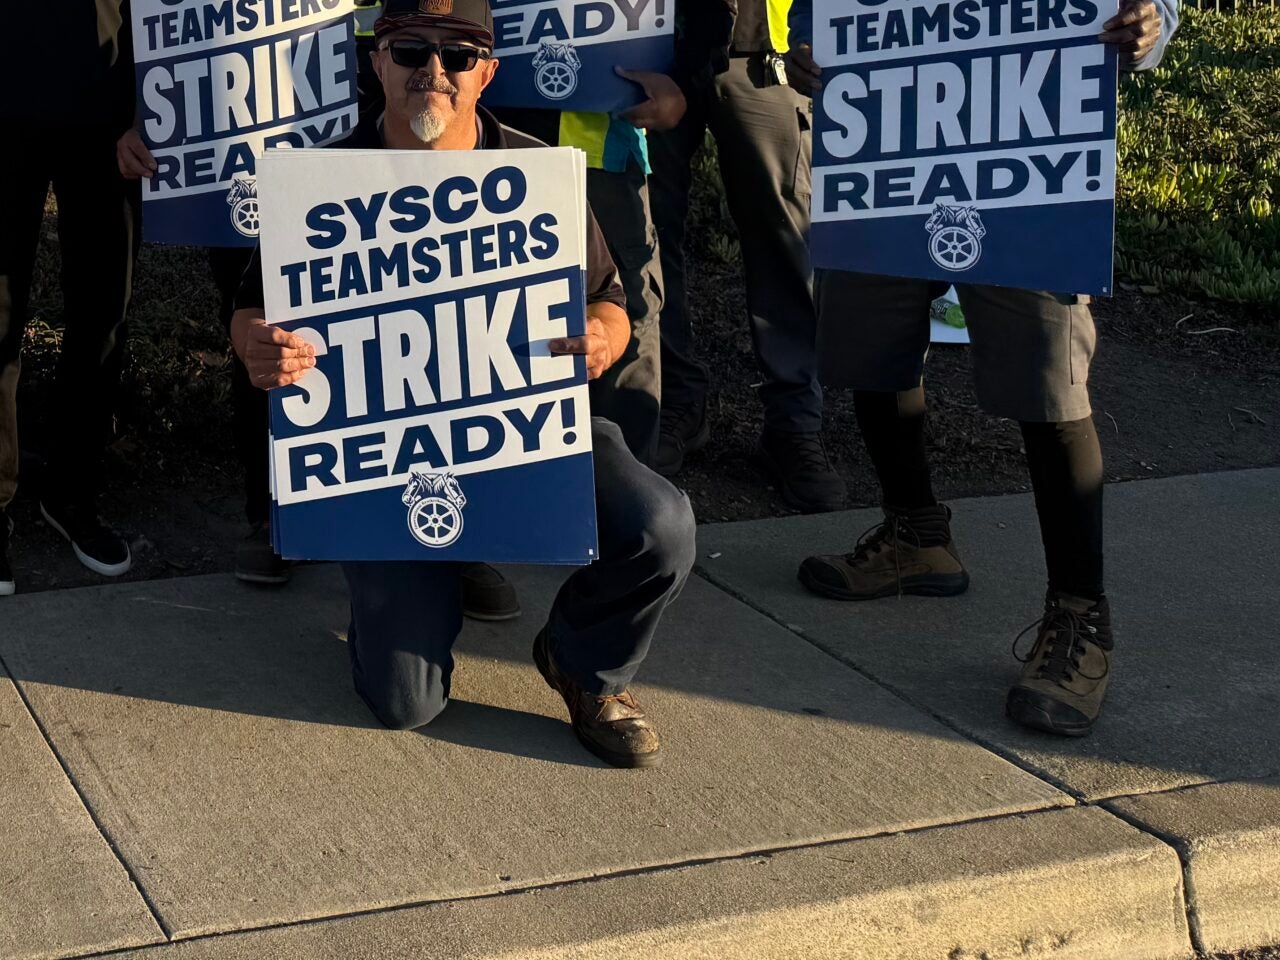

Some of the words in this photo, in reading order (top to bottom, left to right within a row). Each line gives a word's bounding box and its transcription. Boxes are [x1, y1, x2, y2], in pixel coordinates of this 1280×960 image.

[142, 22, 351, 143] STRIKE
[821, 43, 1105, 159] STRIKE
[305, 165, 527, 250] SYSCO
[823, 149, 1101, 213] READY!
[280, 212, 559, 308] TEAMSTERS
[281, 278, 575, 428] STRIKE
[288, 397, 577, 493] READY!
